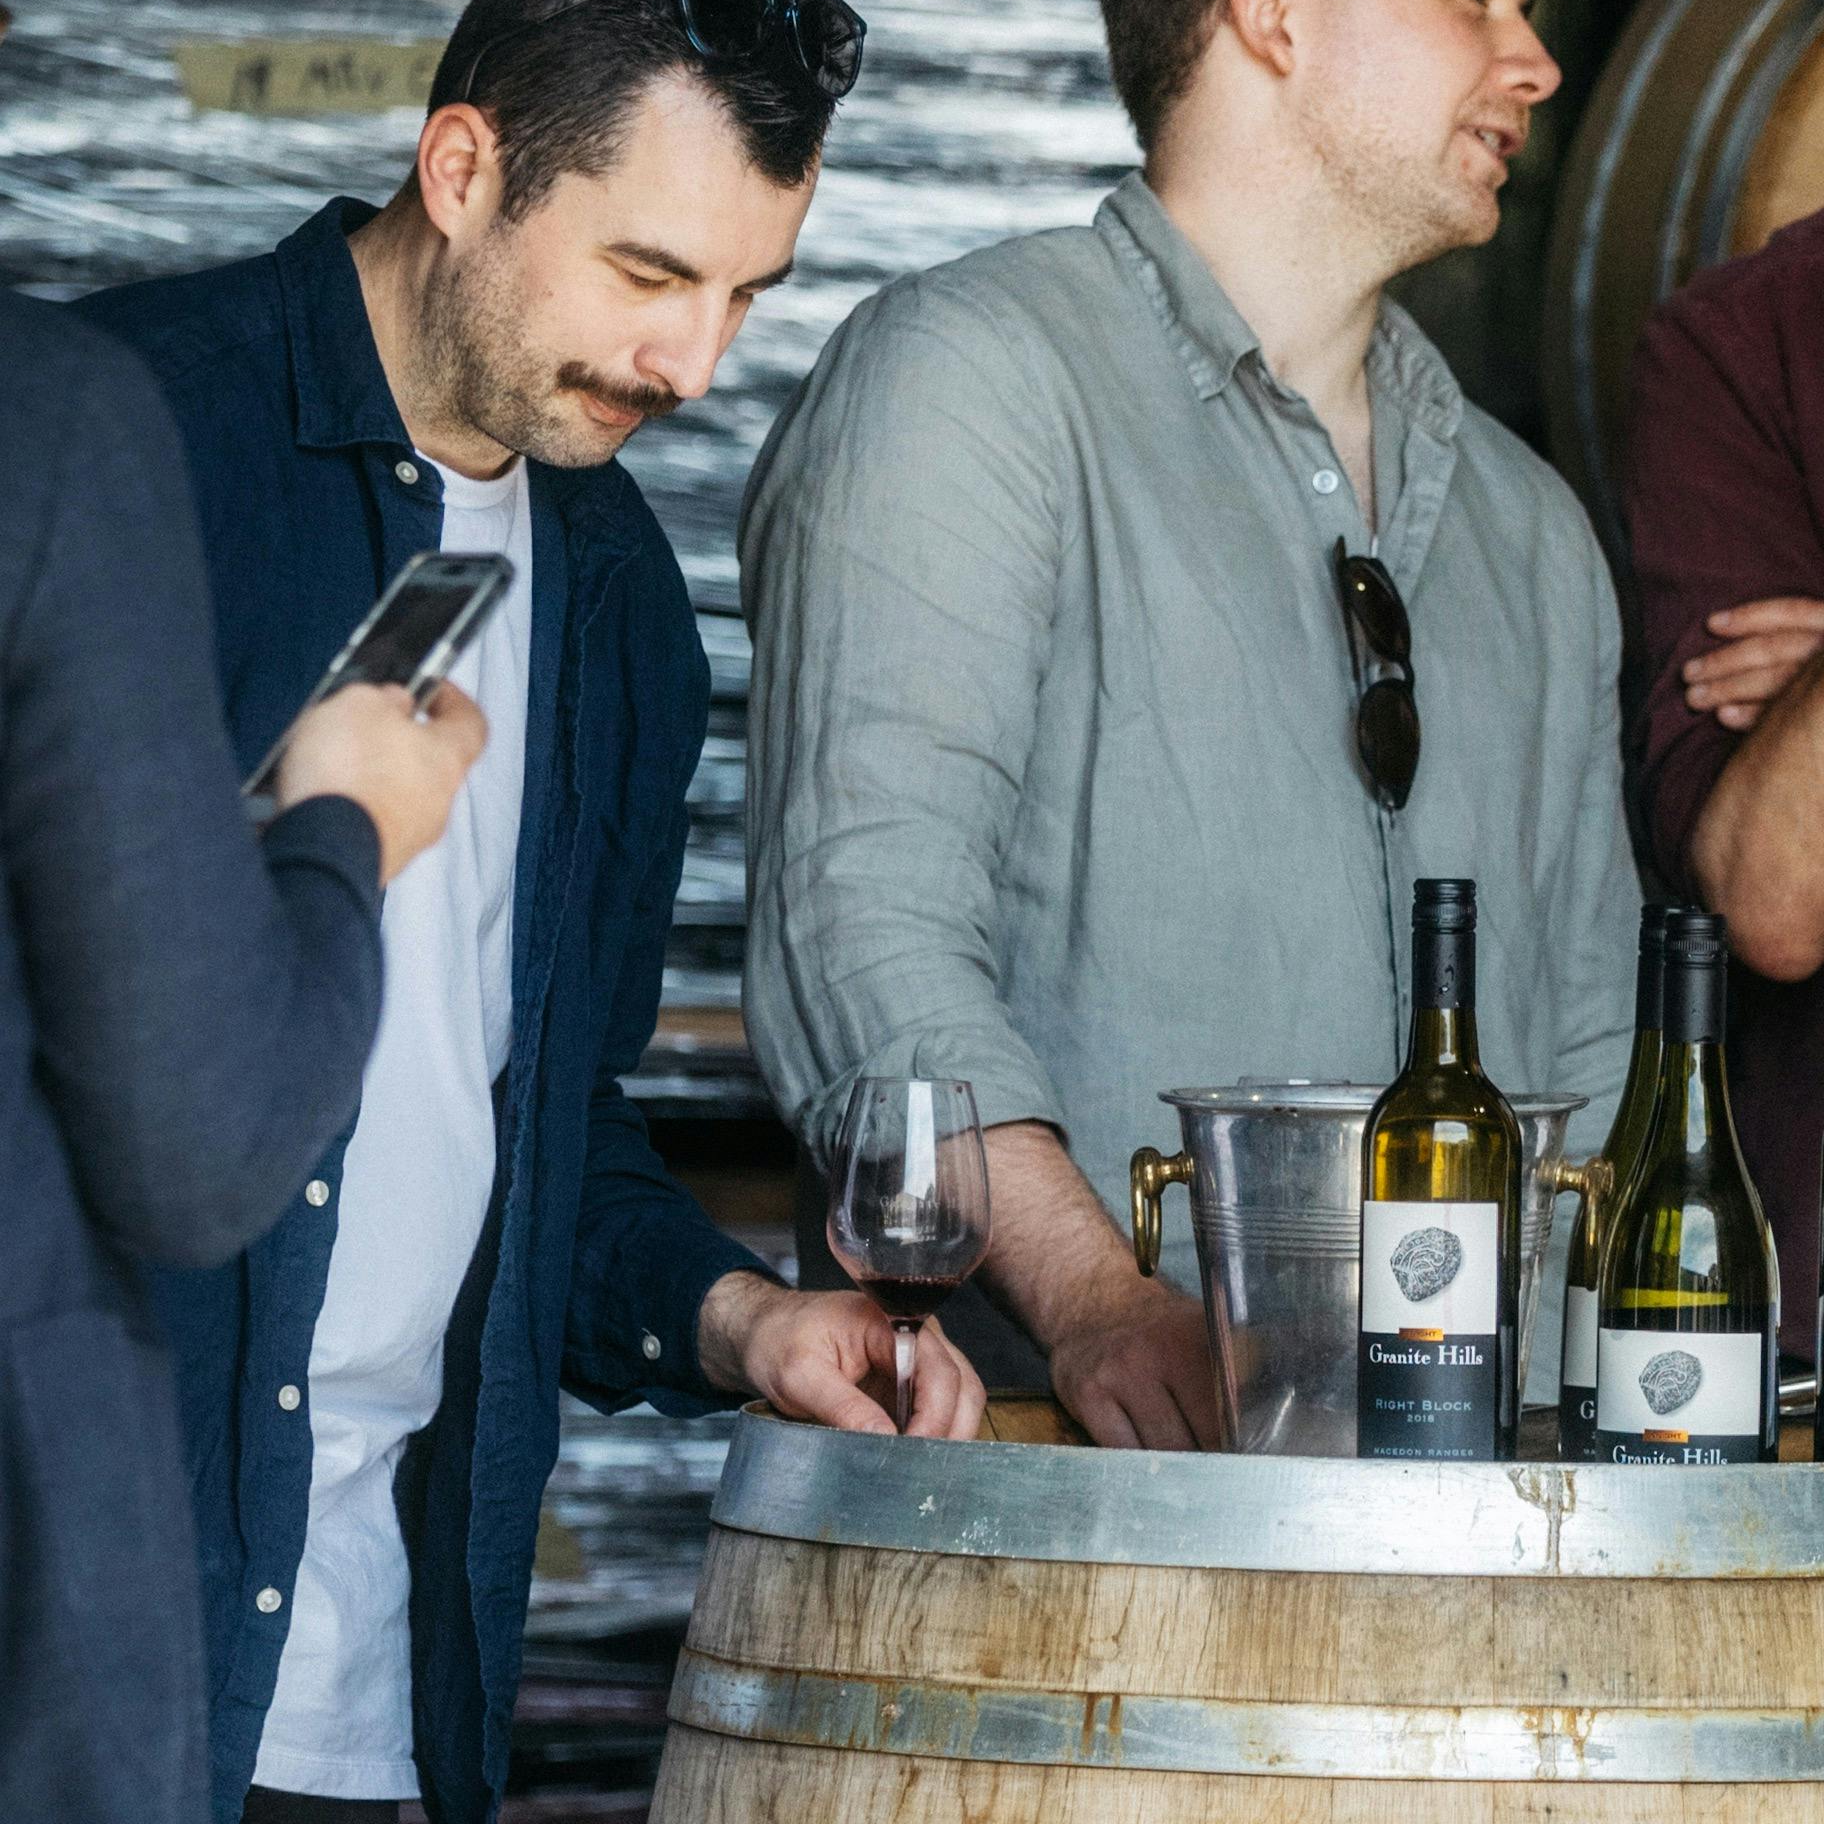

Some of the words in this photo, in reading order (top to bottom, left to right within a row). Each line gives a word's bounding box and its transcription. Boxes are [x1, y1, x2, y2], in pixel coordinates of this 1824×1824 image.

[1369, 1343, 1431, 1365] Granite
[1437, 1345, 1483, 1365] Hills
[1375, 1398, 1415, 1411] RIGHT
[1422, 1400, 1472, 1411] BLOCK
[1407, 1414, 1435, 1423] 2018
[1374, 1447, 1422, 1457] MACEDON
[1428, 1448, 1474, 1457] RANGES
